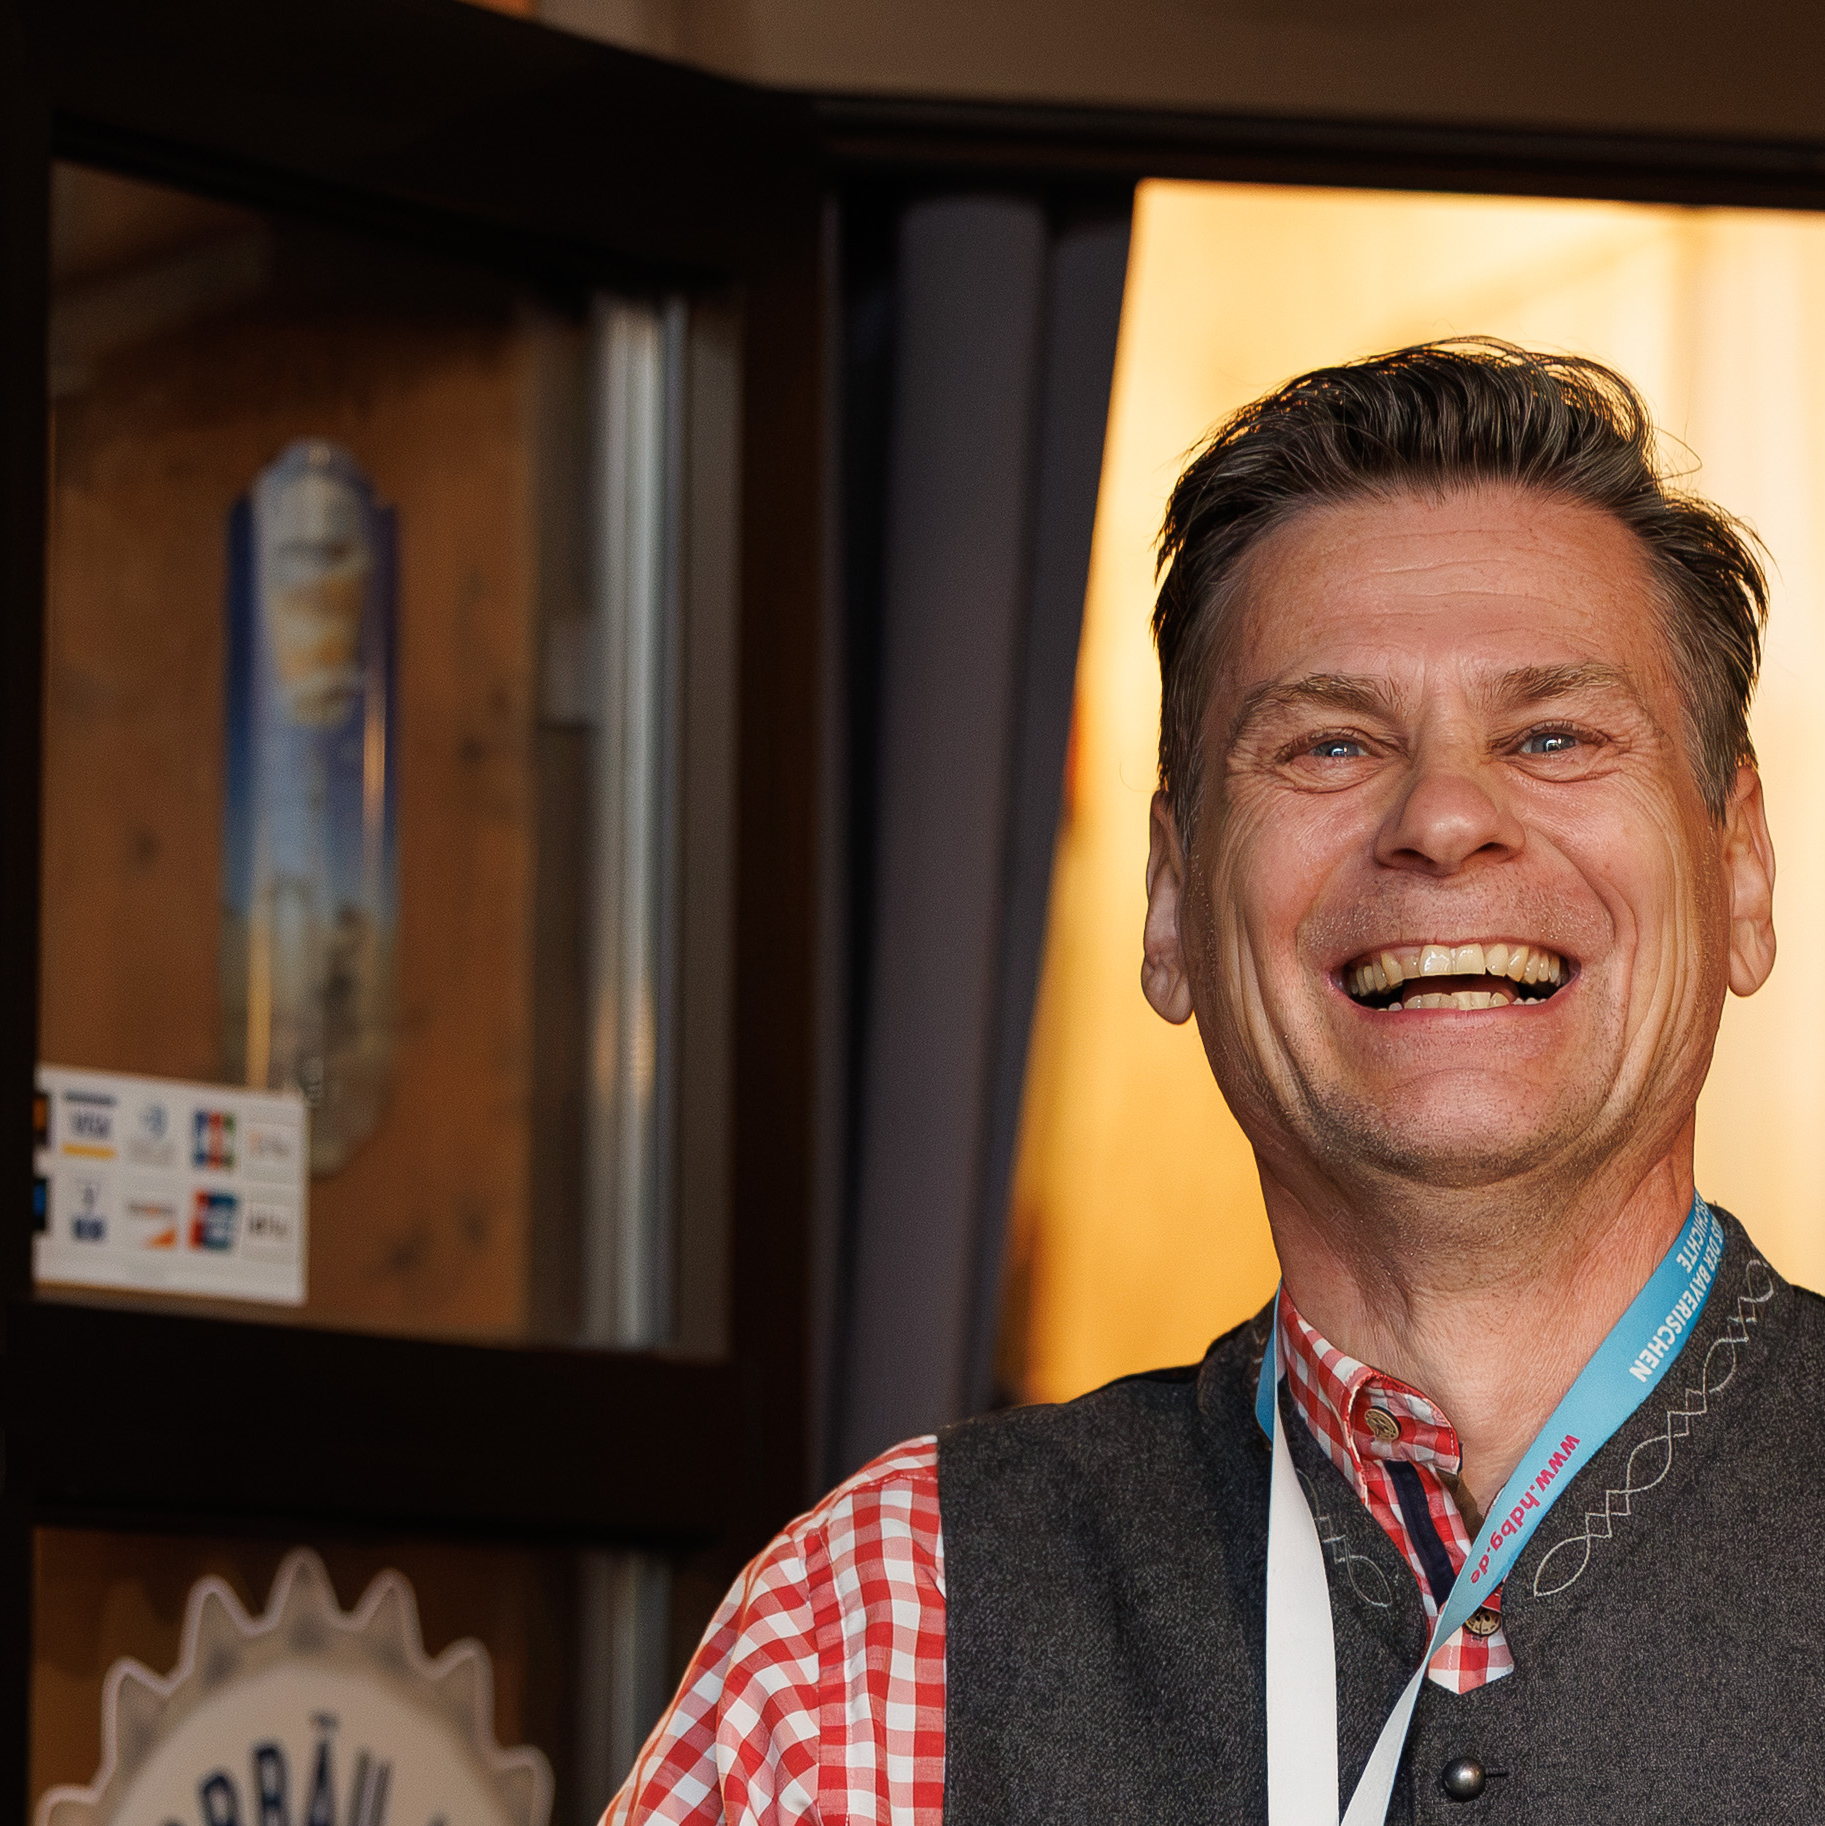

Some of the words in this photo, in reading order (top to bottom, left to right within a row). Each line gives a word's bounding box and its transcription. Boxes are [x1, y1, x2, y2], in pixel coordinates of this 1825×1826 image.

[1676, 1193, 1709, 1273] ESCHICHTE
[1702, 1235, 1722, 1273] DER
[1629, 1265, 1712, 1382] BAYERISCHEN
[1470, 1434, 1581, 1584] www.hdbg.de
